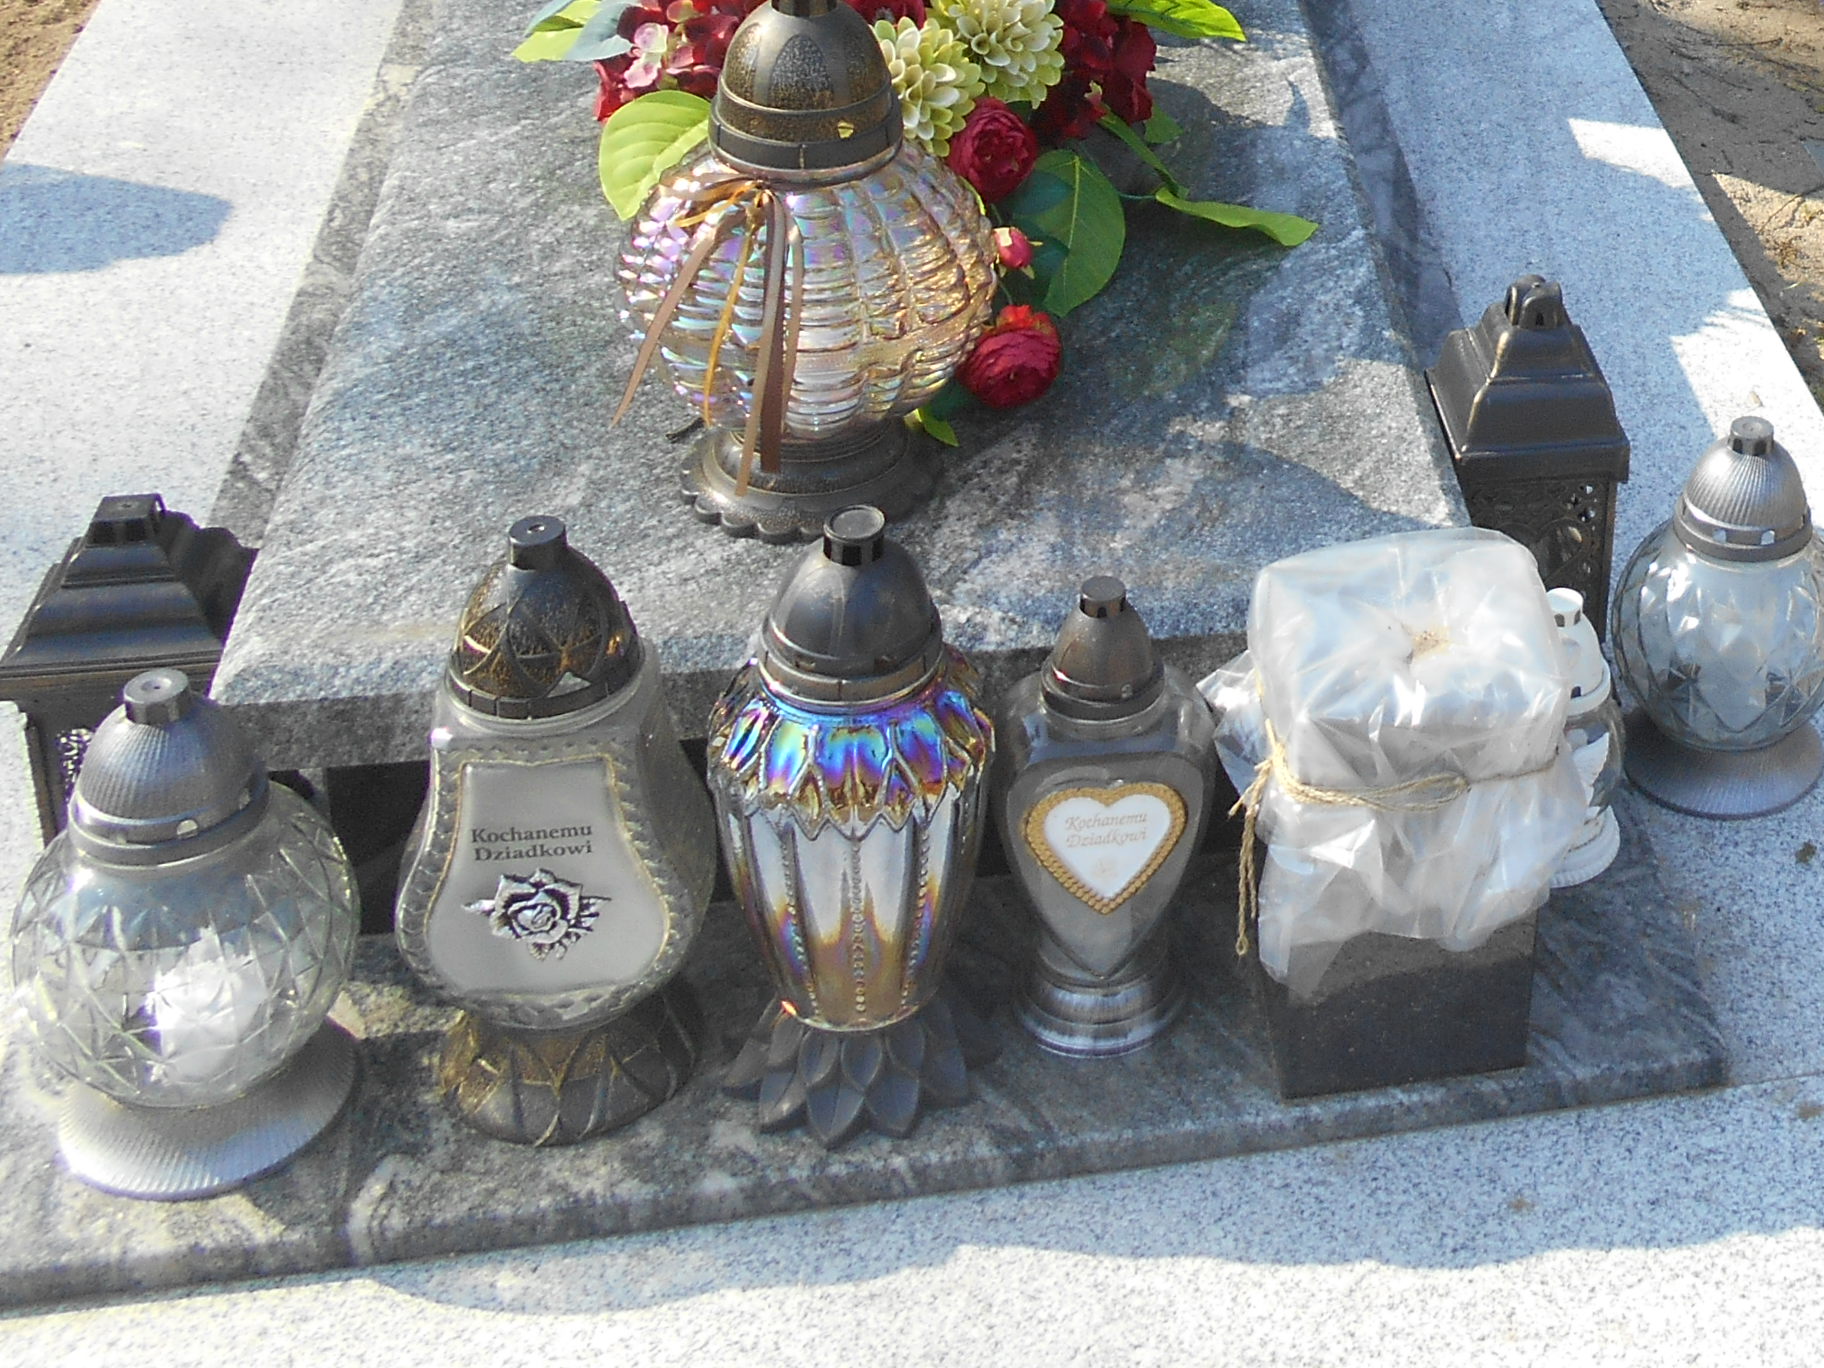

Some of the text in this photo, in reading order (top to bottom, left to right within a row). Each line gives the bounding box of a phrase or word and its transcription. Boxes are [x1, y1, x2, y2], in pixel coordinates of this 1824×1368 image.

[1065, 813, 1147, 831] Kochanemu
[471, 823, 592, 844] Kochanemu
[1066, 827, 1147, 848] Dziadkowi
[474, 840, 592, 862] Dziadkowi
